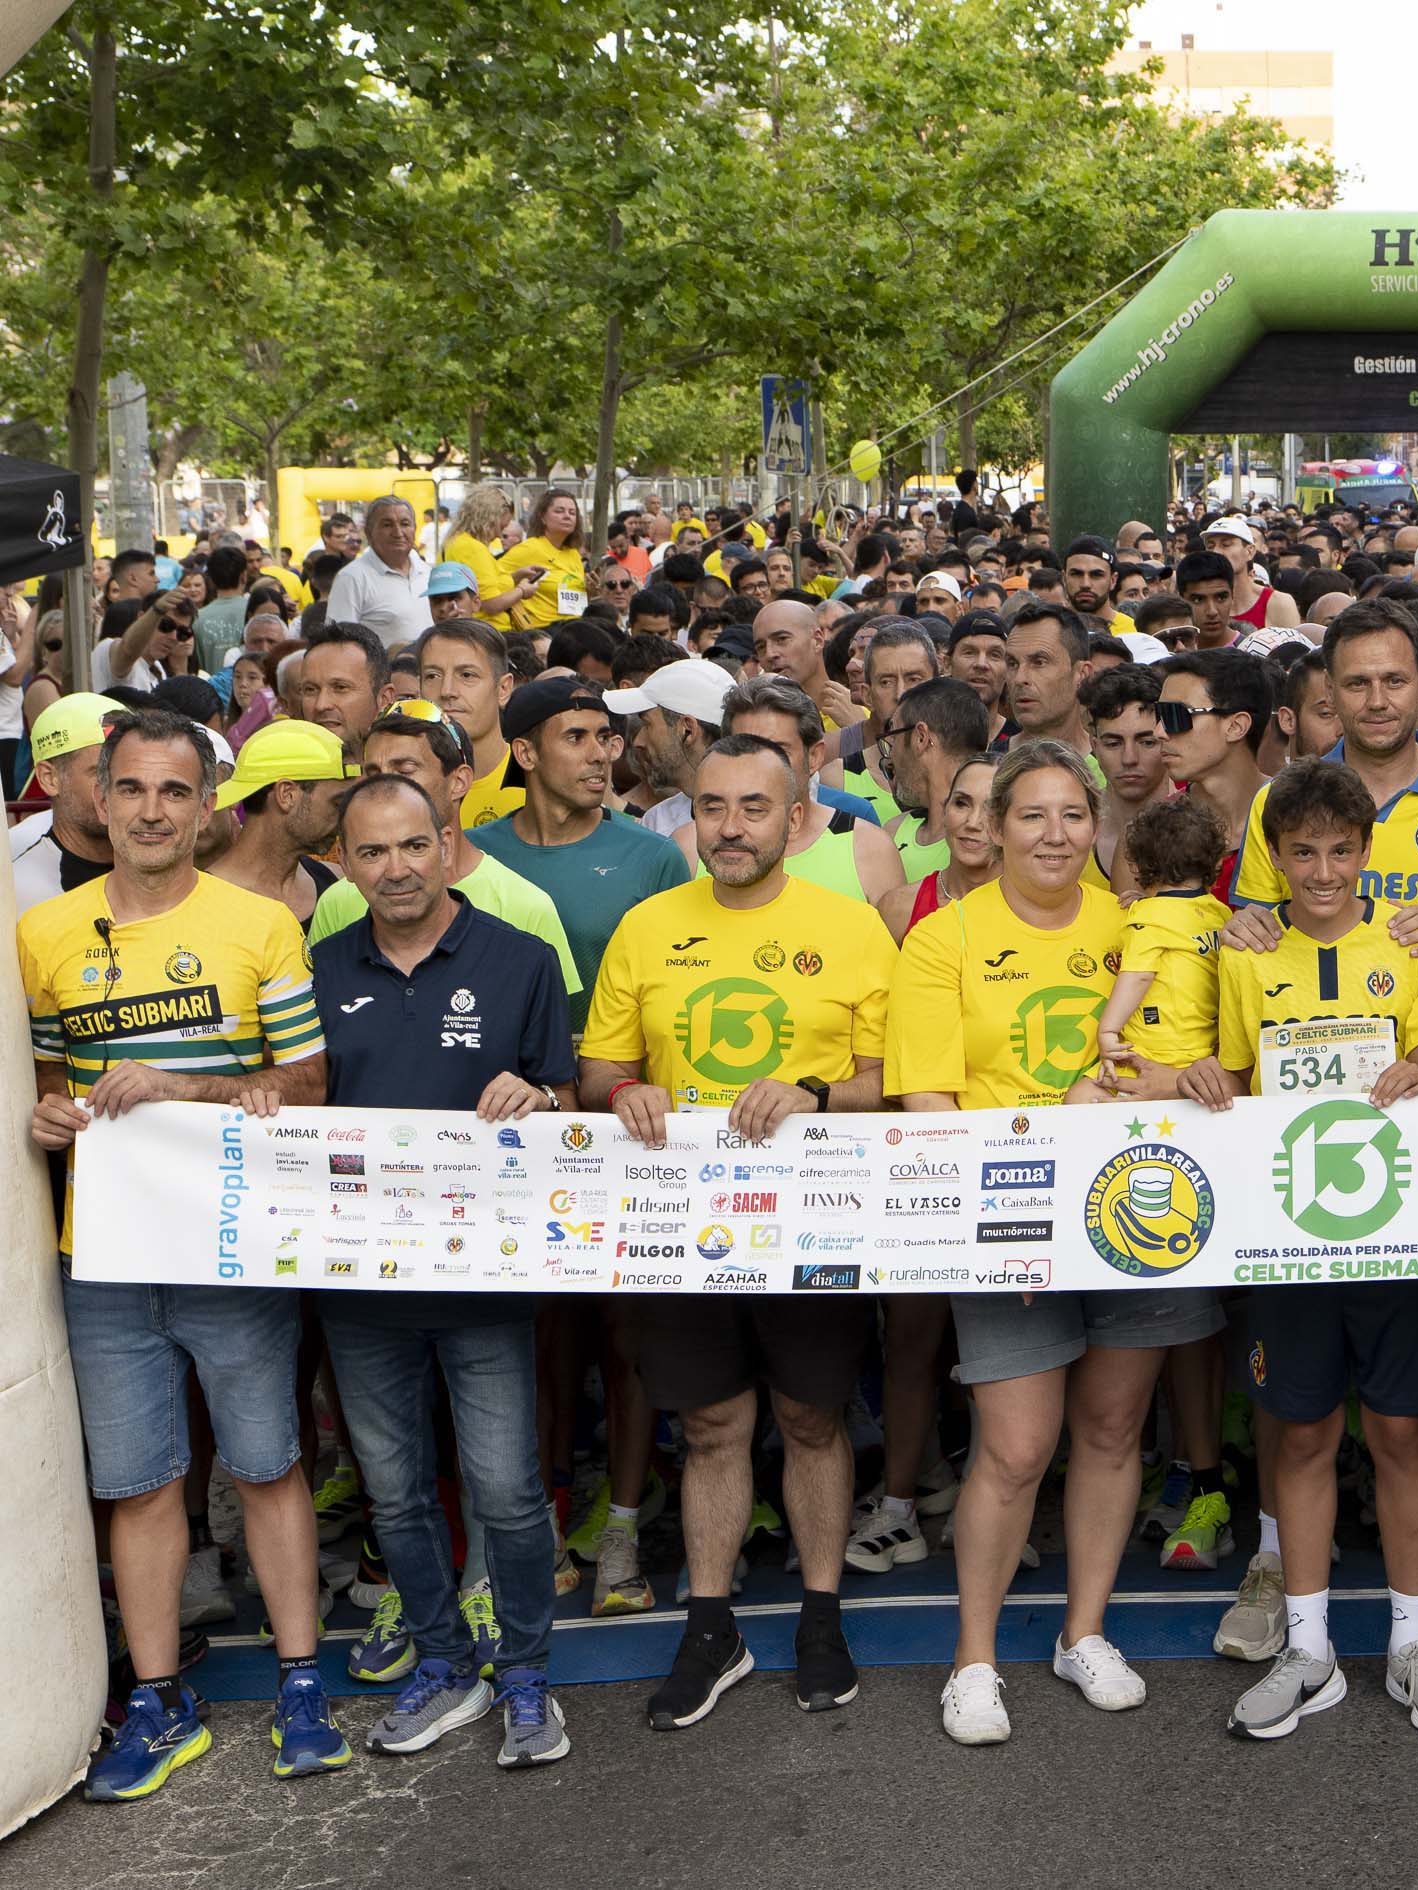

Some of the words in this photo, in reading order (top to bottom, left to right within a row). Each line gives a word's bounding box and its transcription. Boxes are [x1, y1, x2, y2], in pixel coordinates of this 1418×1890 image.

[1103, 272, 1235, 403] www.hj-crono.es
[1354, 356, 1416, 373] Gestión
[561, 592, 579, 601] 1859
[665, 956, 711, 970] ENDAVANT
[984, 969, 1029, 982] ENDAVANT
[64, 1010, 114, 1037] CELTIC
[118, 991, 213, 1030] SUBMARÍ
[442, 1015, 481, 1023] Ajuntament
[180, 1025, 221, 1038] VILA-REAL
[1295, 1030, 1328, 1040] CELTIC
[1331, 1026, 1376, 1036] SUBMARÍ
[441, 1032, 481, 1048] SME
[1296, 1046, 1327, 1056] PABLO
[1279, 1054, 1346, 1090] 534
[275, 1128, 319, 1138] AMBAR
[803, 1128, 829, 1141] A&A
[984, 1138, 1037, 1147] VILLARREAL
[1041, 1137, 1056, 1145] C.F.
[805, 1146, 853, 1159] podoactiva
[552, 1156, 604, 1165] Ajuntament
[564, 1165, 601, 1174] Vila-real
[624, 1164, 687, 1180] Isoltec
[799, 1168, 871, 1178] cifrecerámica
[890, 1161, 960, 1177] COVALCA
[1130, 1147, 1206, 1192] VILA-REAL
[1292, 1119, 1390, 1221] 13
[659, 1180, 687, 1190] Group
[640, 1197, 690, 1213] disinel
[733, 1193, 778, 1213] SACMI
[885, 1198, 902, 1209] EL
[910, 1197, 961, 1209] VASCO
[1001, 1197, 1053, 1209] CaixaBank
[1198, 1192, 1211, 1229] CSC
[546, 1222, 605, 1242] SME
[842, 1235, 864, 1243] rural
[904, 1238, 935, 1247] Quadis
[938, 1237, 966, 1246] Marzá
[616, 1241, 685, 1257] FULGOR
[1090, 1228, 1142, 1273] CELTIC
[1235, 1249, 1279, 1258] CURSA
[1282, 1245, 1352, 1257] SOLIDÀRIA
[1356, 1245, 1380, 1255] PER
[331, 1263, 351, 1272] EVA
[890, 1266, 969, 1281] ruralnostra
[1234, 1263, 1322, 1282] CELTIC
[622, 1273, 682, 1285] incerco
[704, 1273, 767, 1284] AZAHAR
[976, 1270, 1043, 1285] vidres
